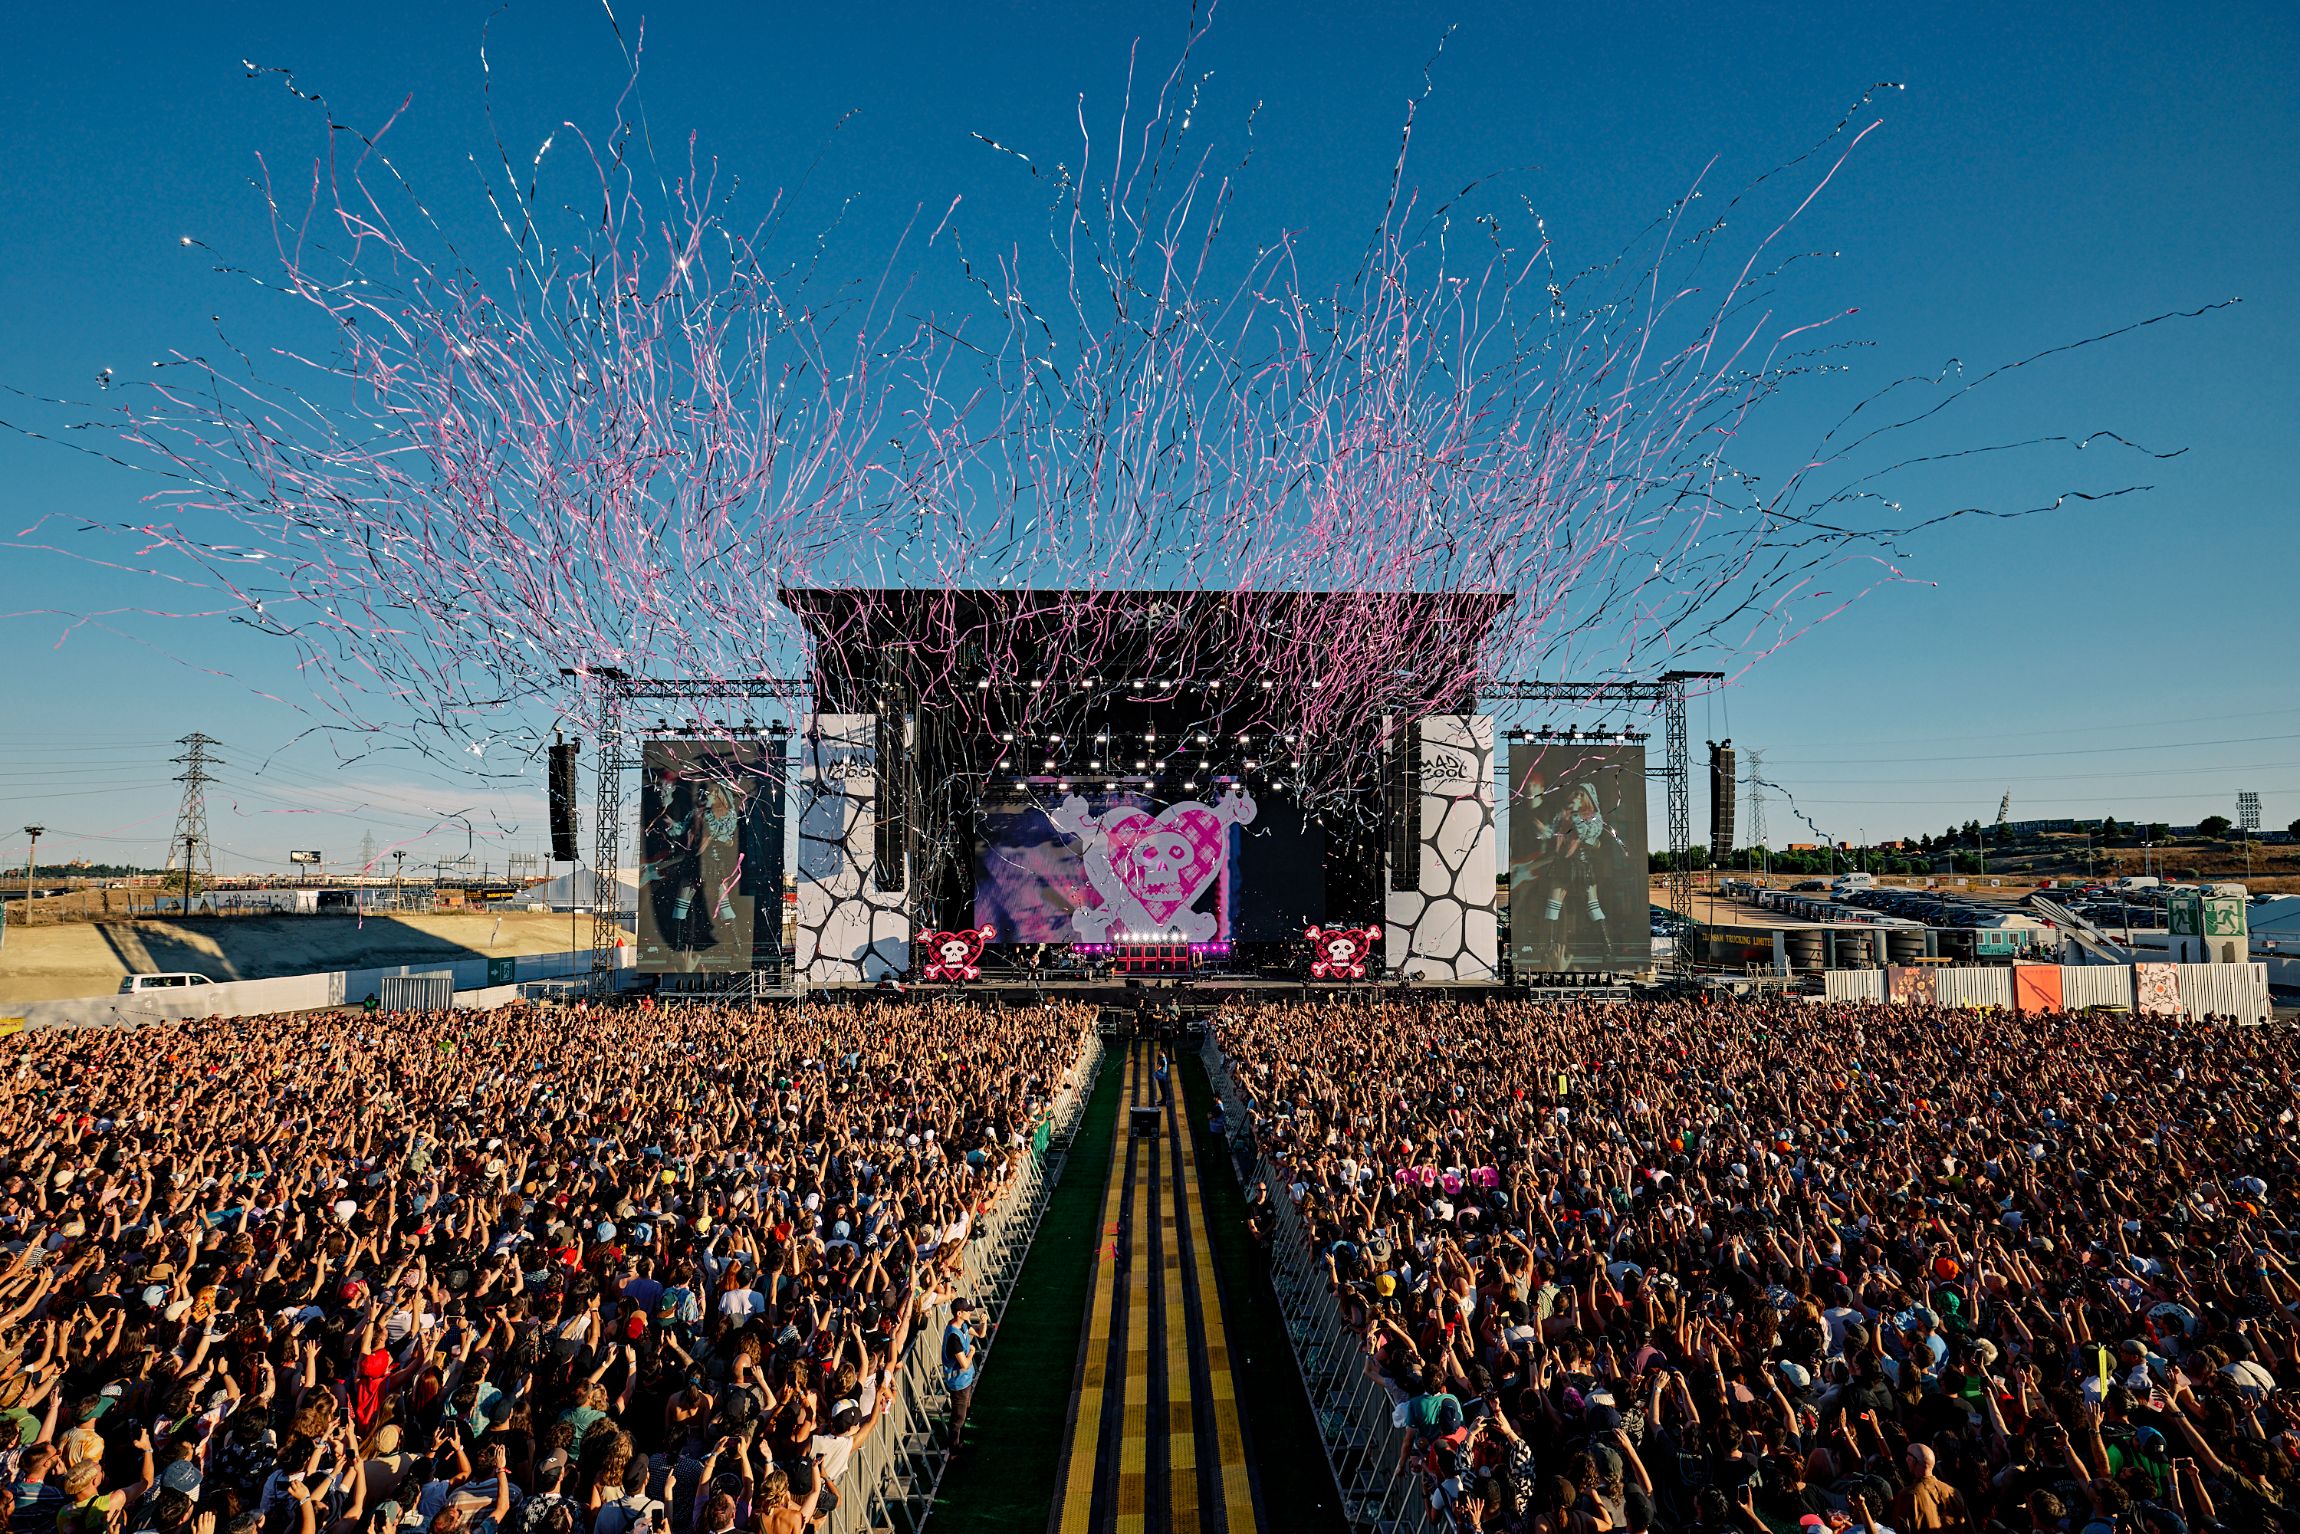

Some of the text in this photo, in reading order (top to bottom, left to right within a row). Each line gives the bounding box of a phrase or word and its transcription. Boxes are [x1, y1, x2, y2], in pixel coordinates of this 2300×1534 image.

[828, 754, 872, 778] MAD
[1421, 754, 1459, 769] MAD
[1421, 761, 1468, 780] COOL
[1726, 934, 1751, 945] TRUCKING
